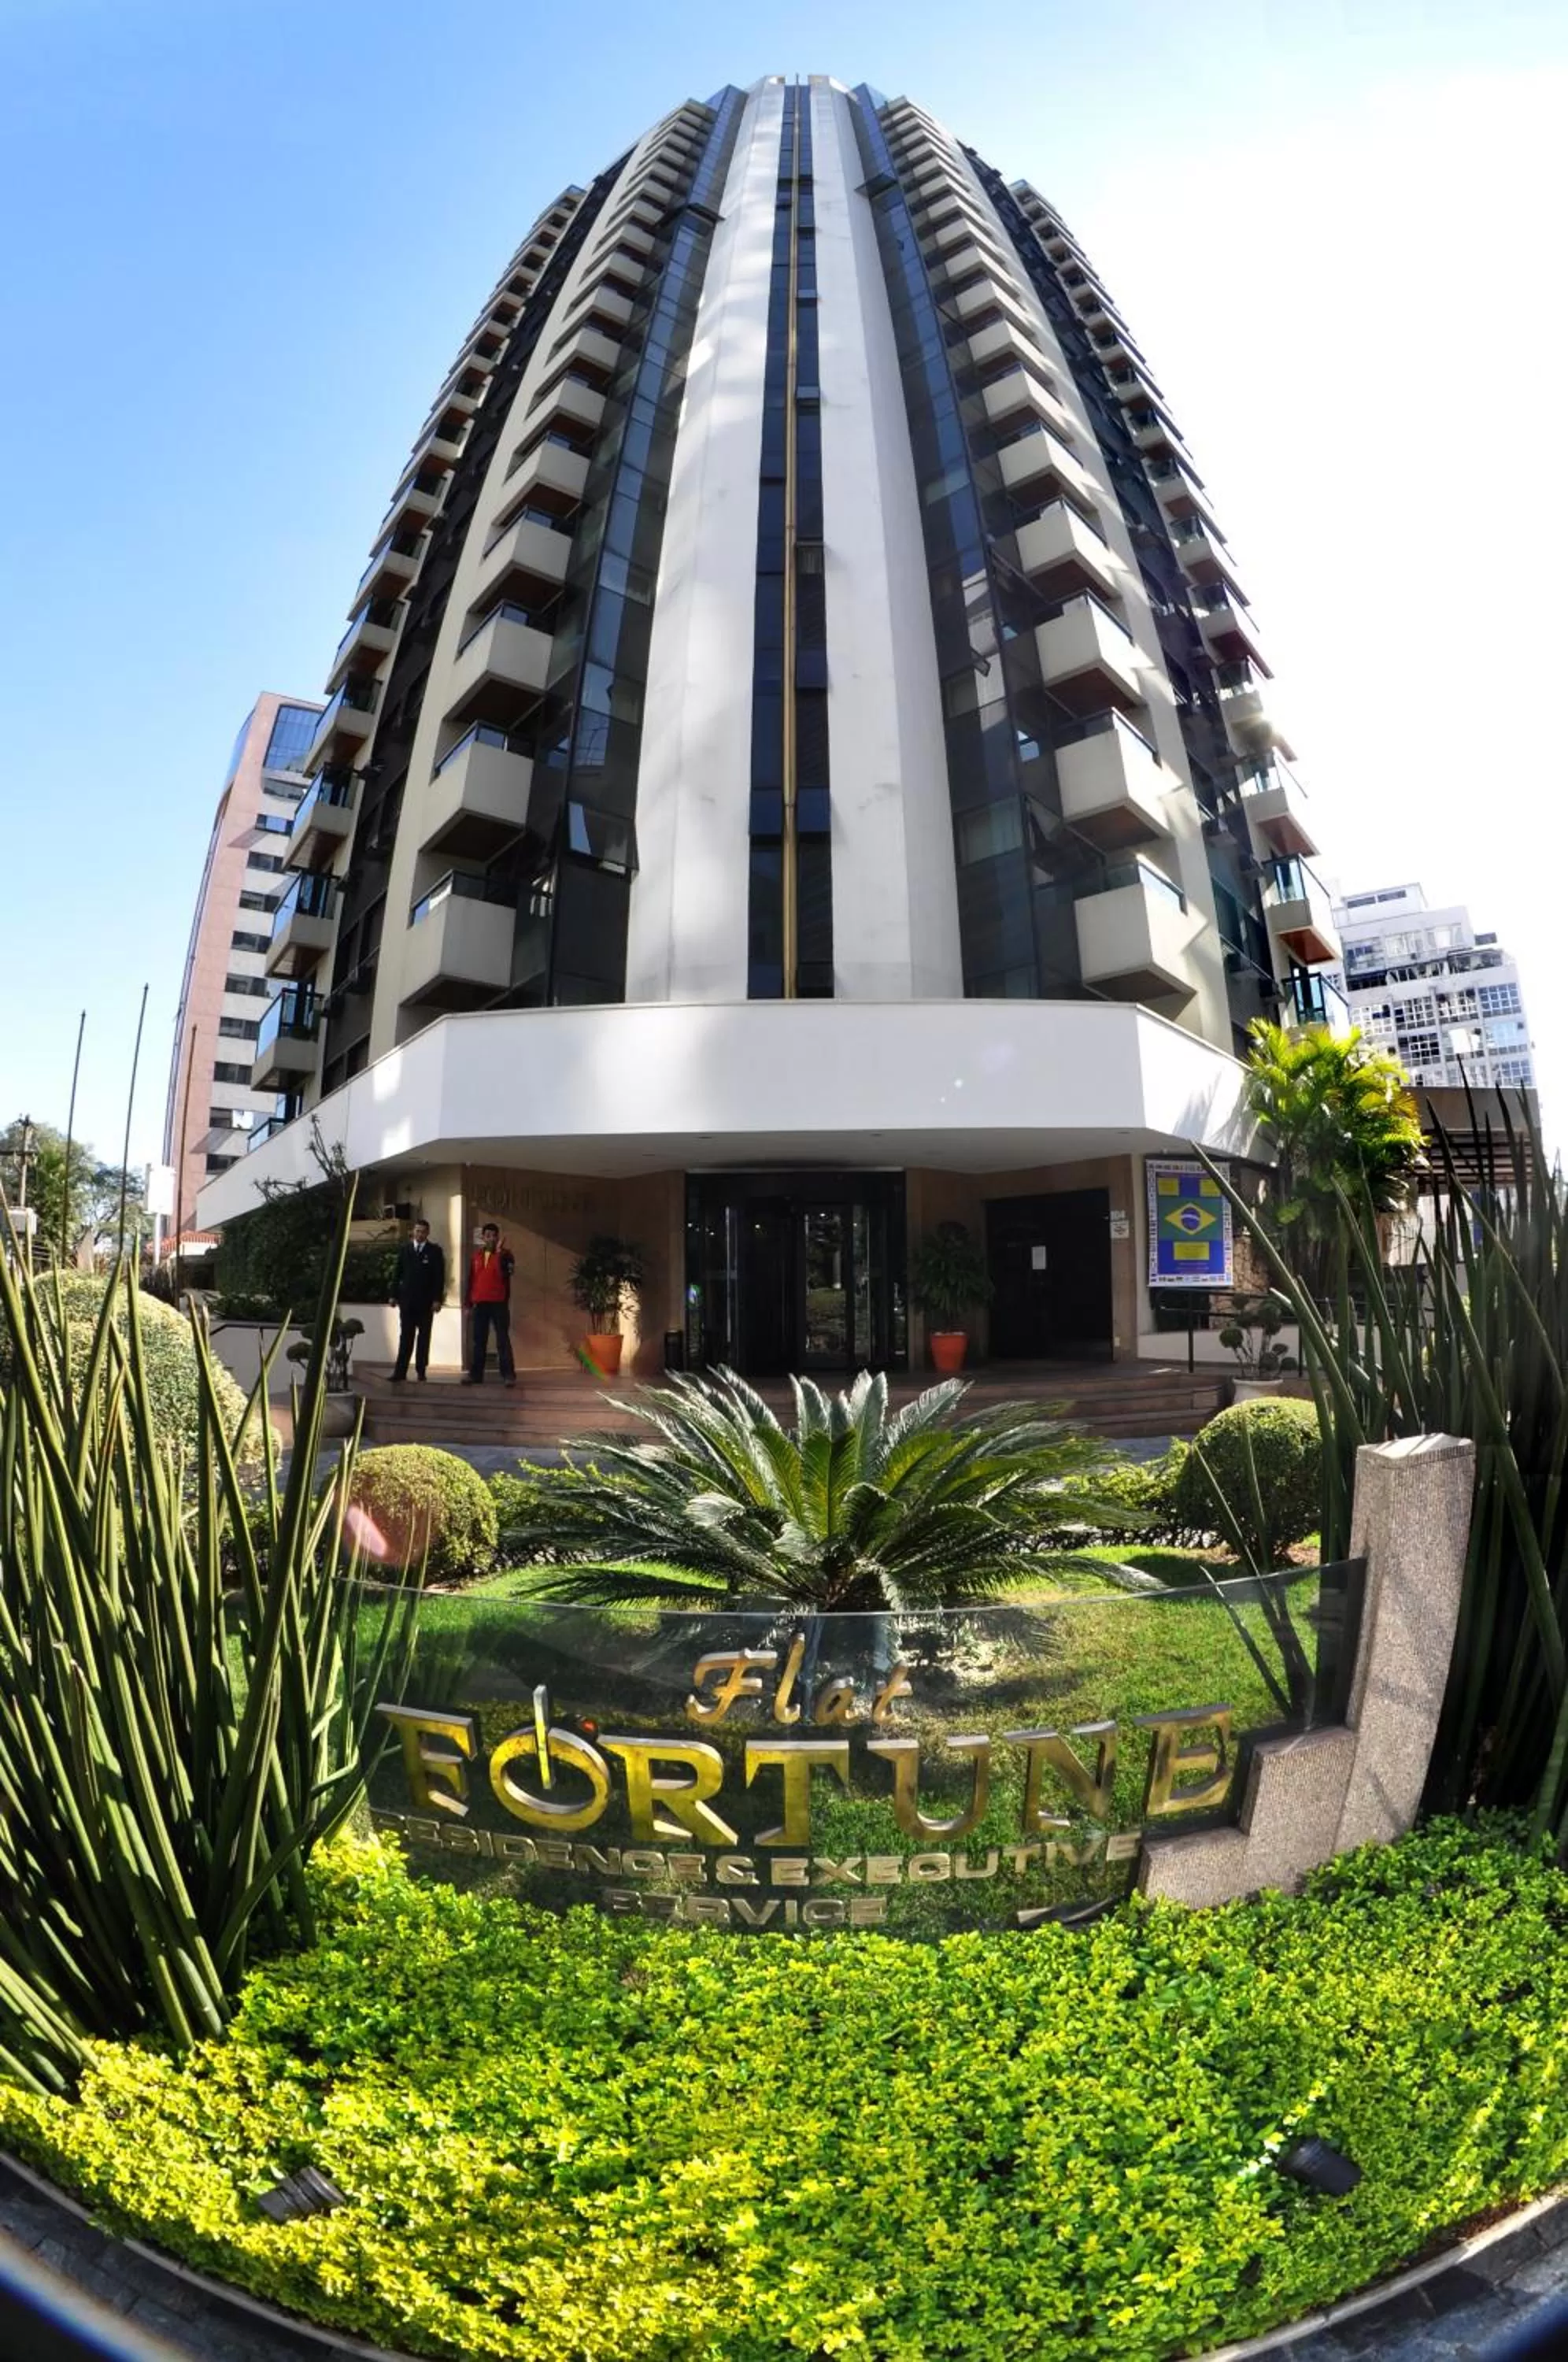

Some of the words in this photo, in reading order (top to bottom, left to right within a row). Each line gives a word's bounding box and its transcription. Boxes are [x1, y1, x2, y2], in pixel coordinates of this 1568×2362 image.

[685, 1633, 913, 1726] Flat
[375, 1685, 1233, 1847] FORTUNE
[715, 1854, 760, 1886] &
[770, 1831, 1142, 1887] EXECUTIVE
[601, 1889, 888, 1927] SERVICE
